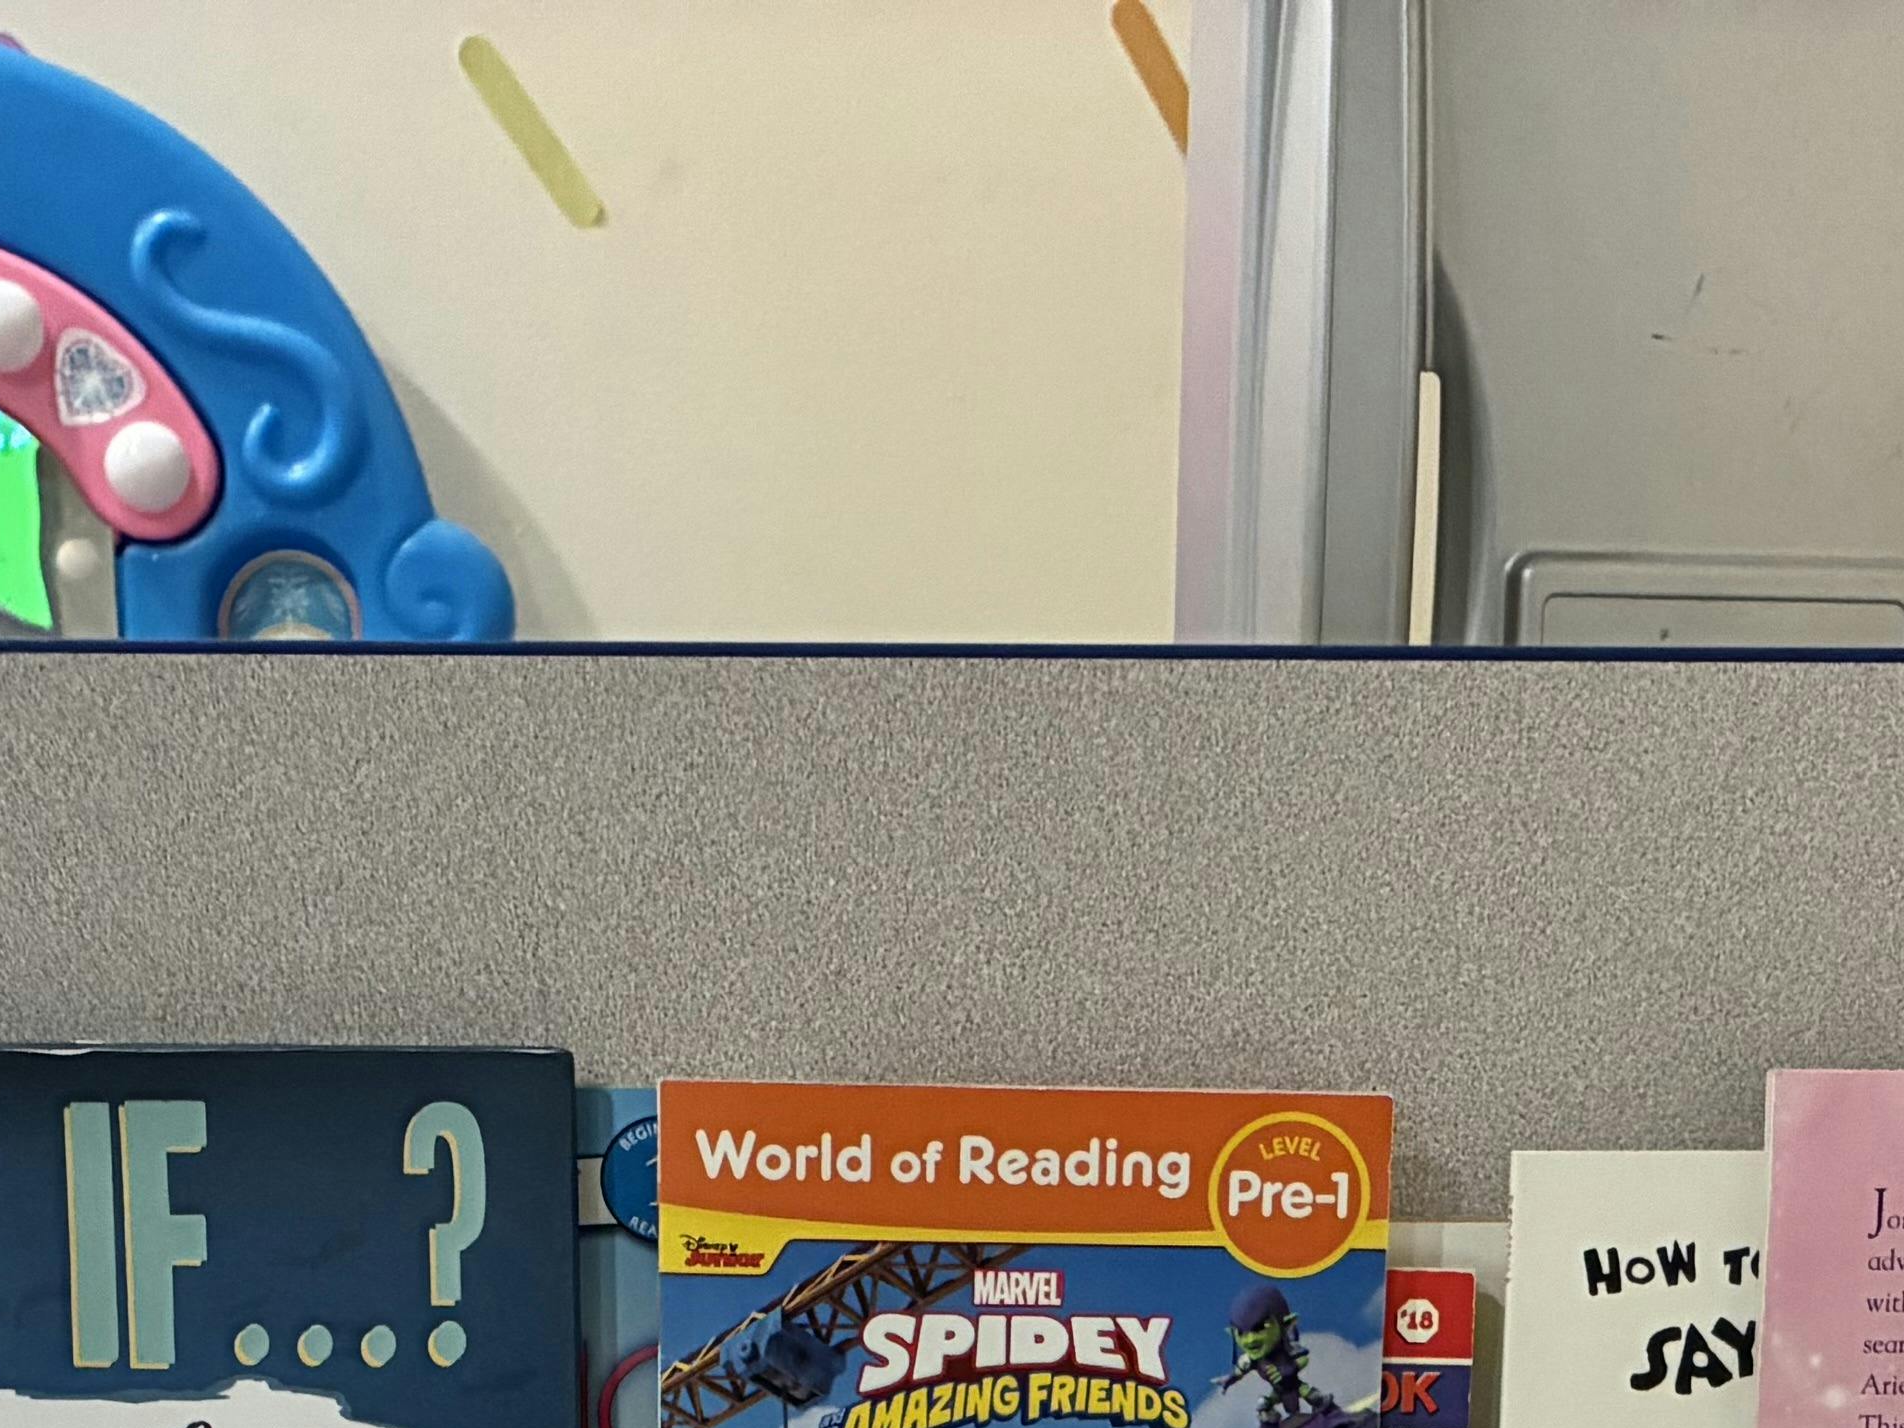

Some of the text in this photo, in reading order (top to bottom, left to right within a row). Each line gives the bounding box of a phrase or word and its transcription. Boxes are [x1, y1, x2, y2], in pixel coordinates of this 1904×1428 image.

[695, 1128, 1192, 1199] World of Reading
[1258, 1134, 1323, 1162] LEVEL
[1226, 1169, 1351, 1220] Pre-1
[973, 1270, 1062, 1306] MARVEL
[1583, 1240, 1696, 1297] HOW
[856, 1311, 1172, 1395] SPIDEY
[1630, 1317, 1756, 1395] SAY
